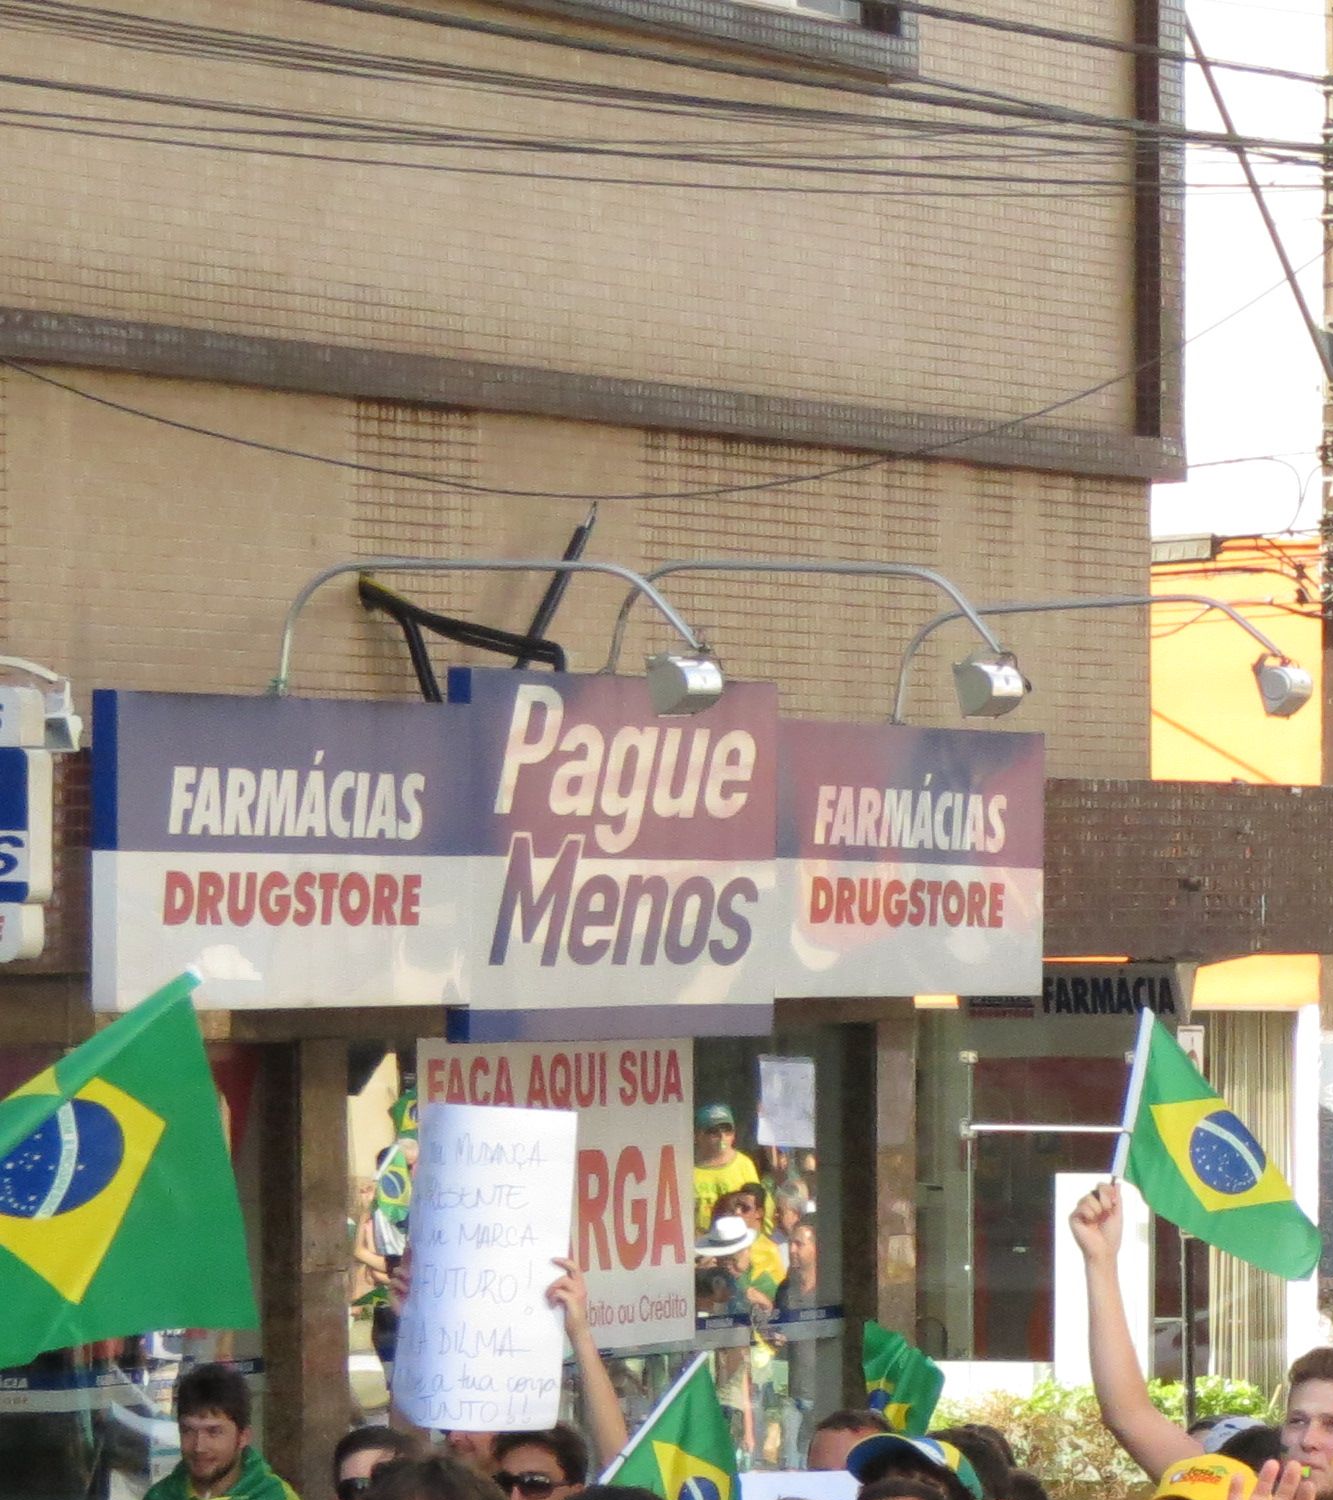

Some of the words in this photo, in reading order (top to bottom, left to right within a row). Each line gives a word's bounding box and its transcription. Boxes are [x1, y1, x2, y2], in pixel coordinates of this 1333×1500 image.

[168, 750, 426, 841] FARMÁCIAS
[494, 684, 757, 854] Pague
[814, 773, 1008, 854] FARMÁCIAS
[162, 870, 422, 927] DRUGSTORE
[488, 831, 759, 967] Menos
[809, 876, 1006, 928] DRUGSTORE
[1043, 968, 1176, 1015] FARMÁCIA
[526, 1051, 607, 1110] AQUI
[618, 1049, 685, 1106] SUA
[569, 1144, 686, 1273] RGA
[585, 1299, 614, 1327] bito
[617, 1303, 635, 1324] ou
[639, 1295, 688, 1323] Crédito
